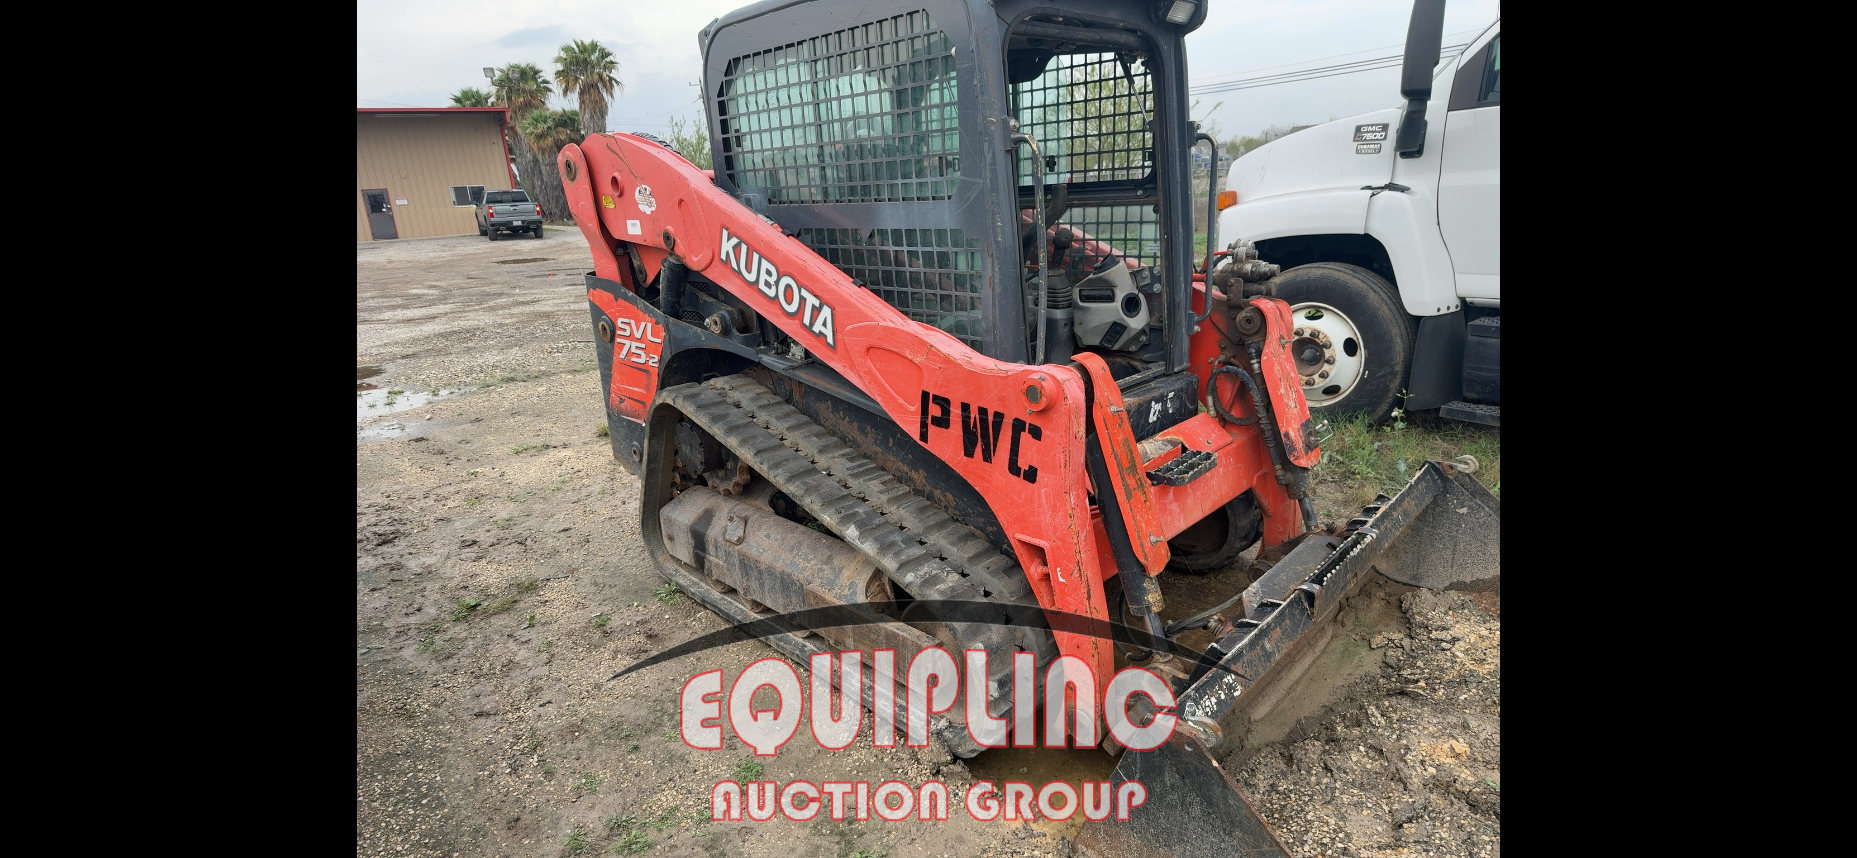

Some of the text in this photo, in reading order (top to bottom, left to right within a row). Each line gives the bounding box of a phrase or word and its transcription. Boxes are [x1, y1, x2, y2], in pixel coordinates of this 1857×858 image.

[616, 317, 662, 344] SVL
[720, 227, 836, 349] KUBOTA
[919, 389, 1042, 485] PWC
